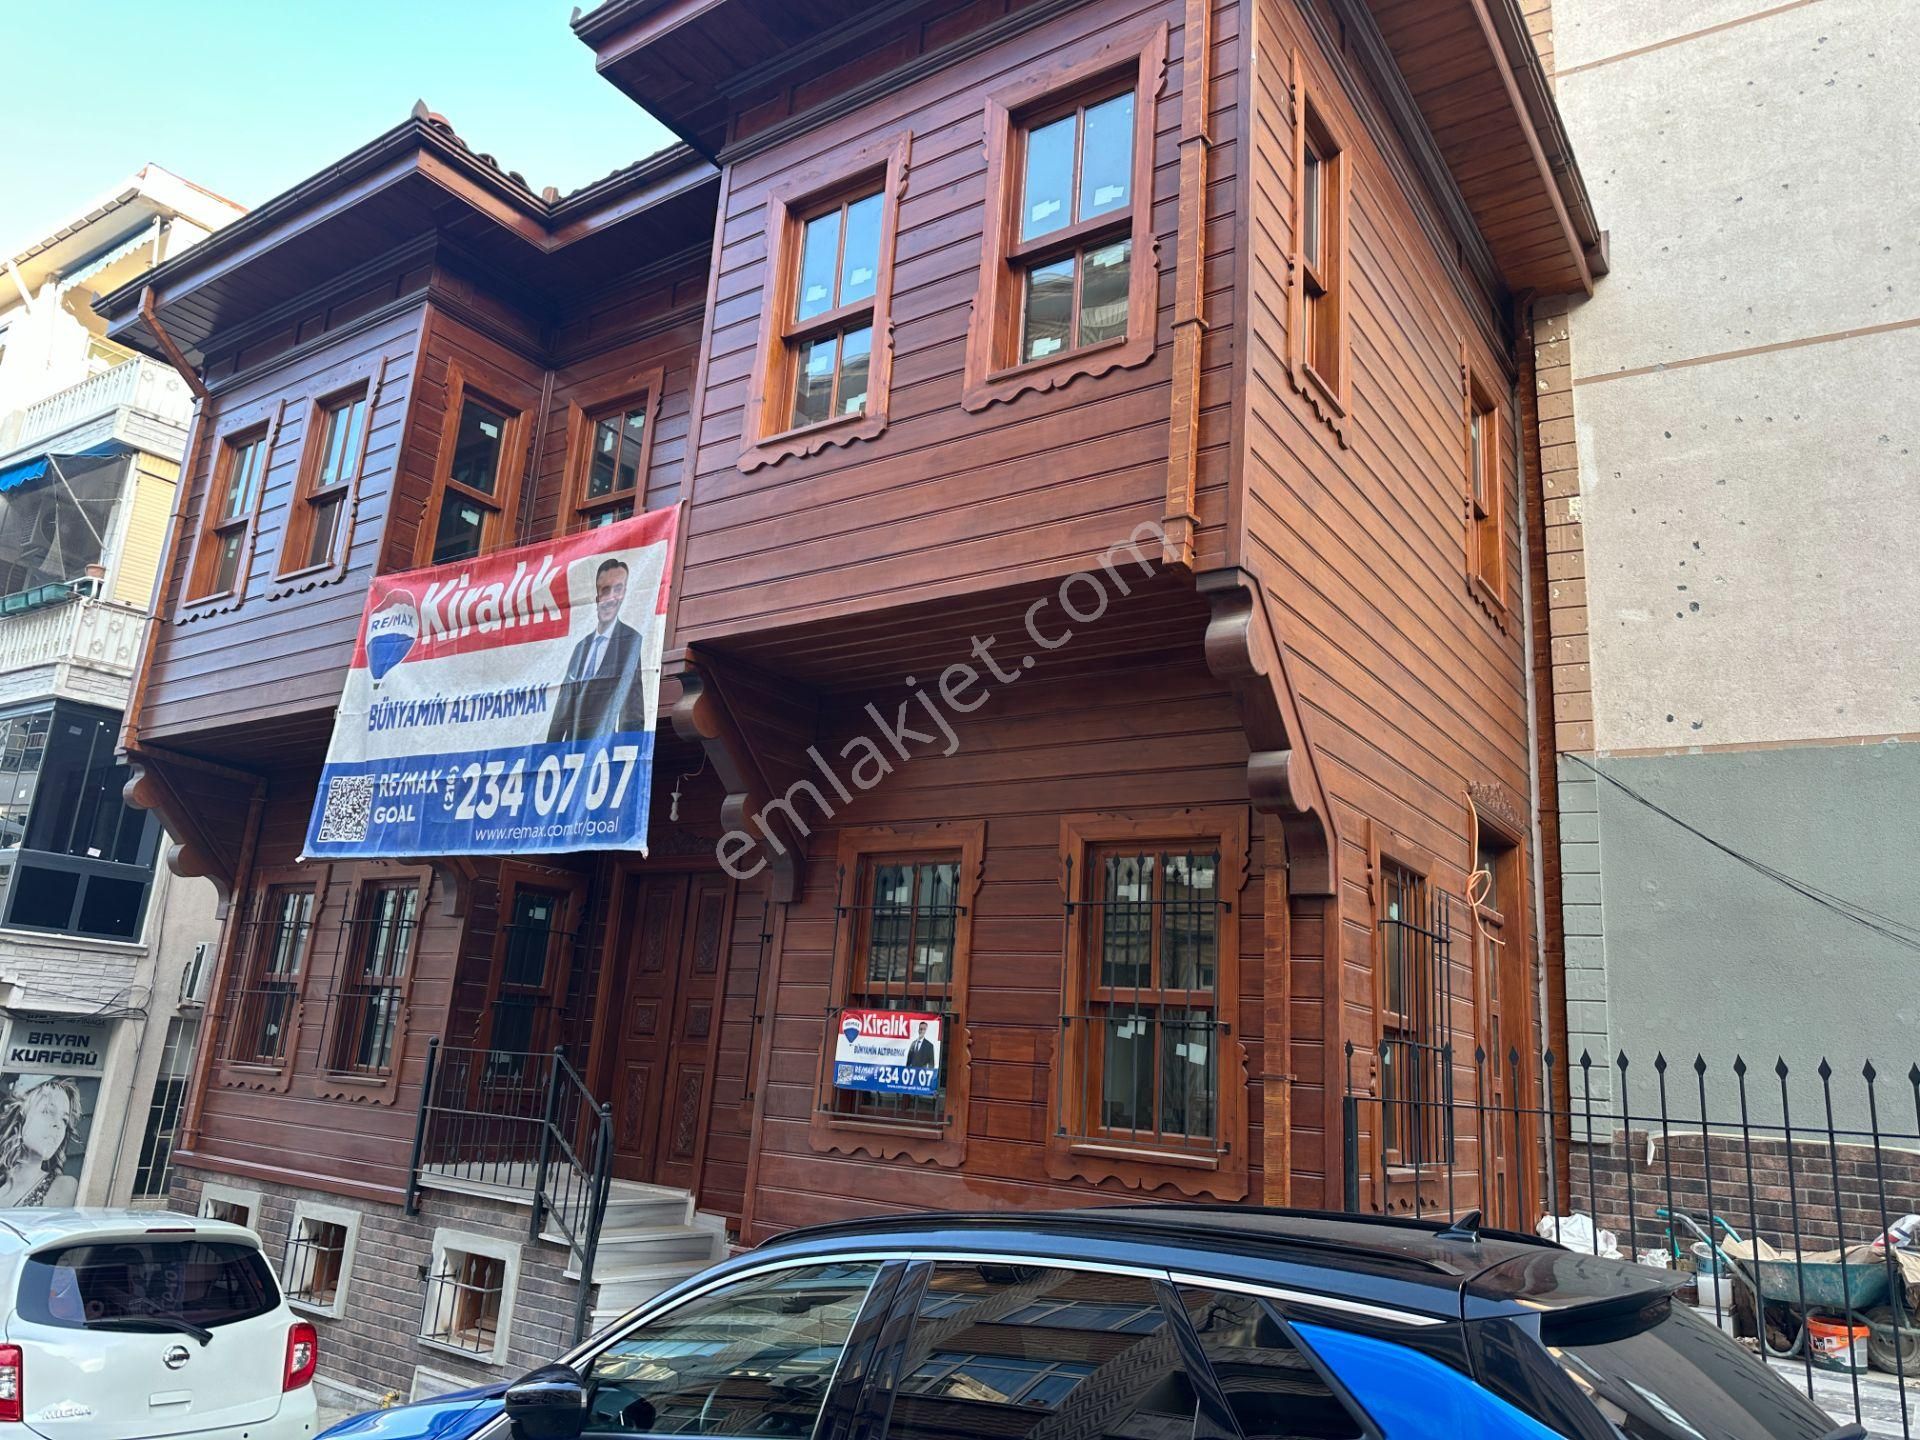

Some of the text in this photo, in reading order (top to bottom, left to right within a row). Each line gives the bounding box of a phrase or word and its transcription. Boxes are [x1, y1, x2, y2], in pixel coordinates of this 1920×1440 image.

[420, 554, 562, 645] Kiralık
[371, 614, 414, 632] RE/MAX
[368, 682, 550, 732] BÜNYAMİN ALTIPARMAK
[378, 769, 443, 798] RE/MAX
[455, 757, 526, 820] 234
[534, 753, 586, 816] 07
[585, 745, 639, 811] 07
[373, 804, 416, 825] GOAL
[863, 1013, 909, 1037] Kiralık
[27, 1031, 91, 1048] BAYAN
[878, 1066, 900, 1085] 234
[901, 1068, 916, 1086] 07
[918, 1069, 934, 1087] 07
